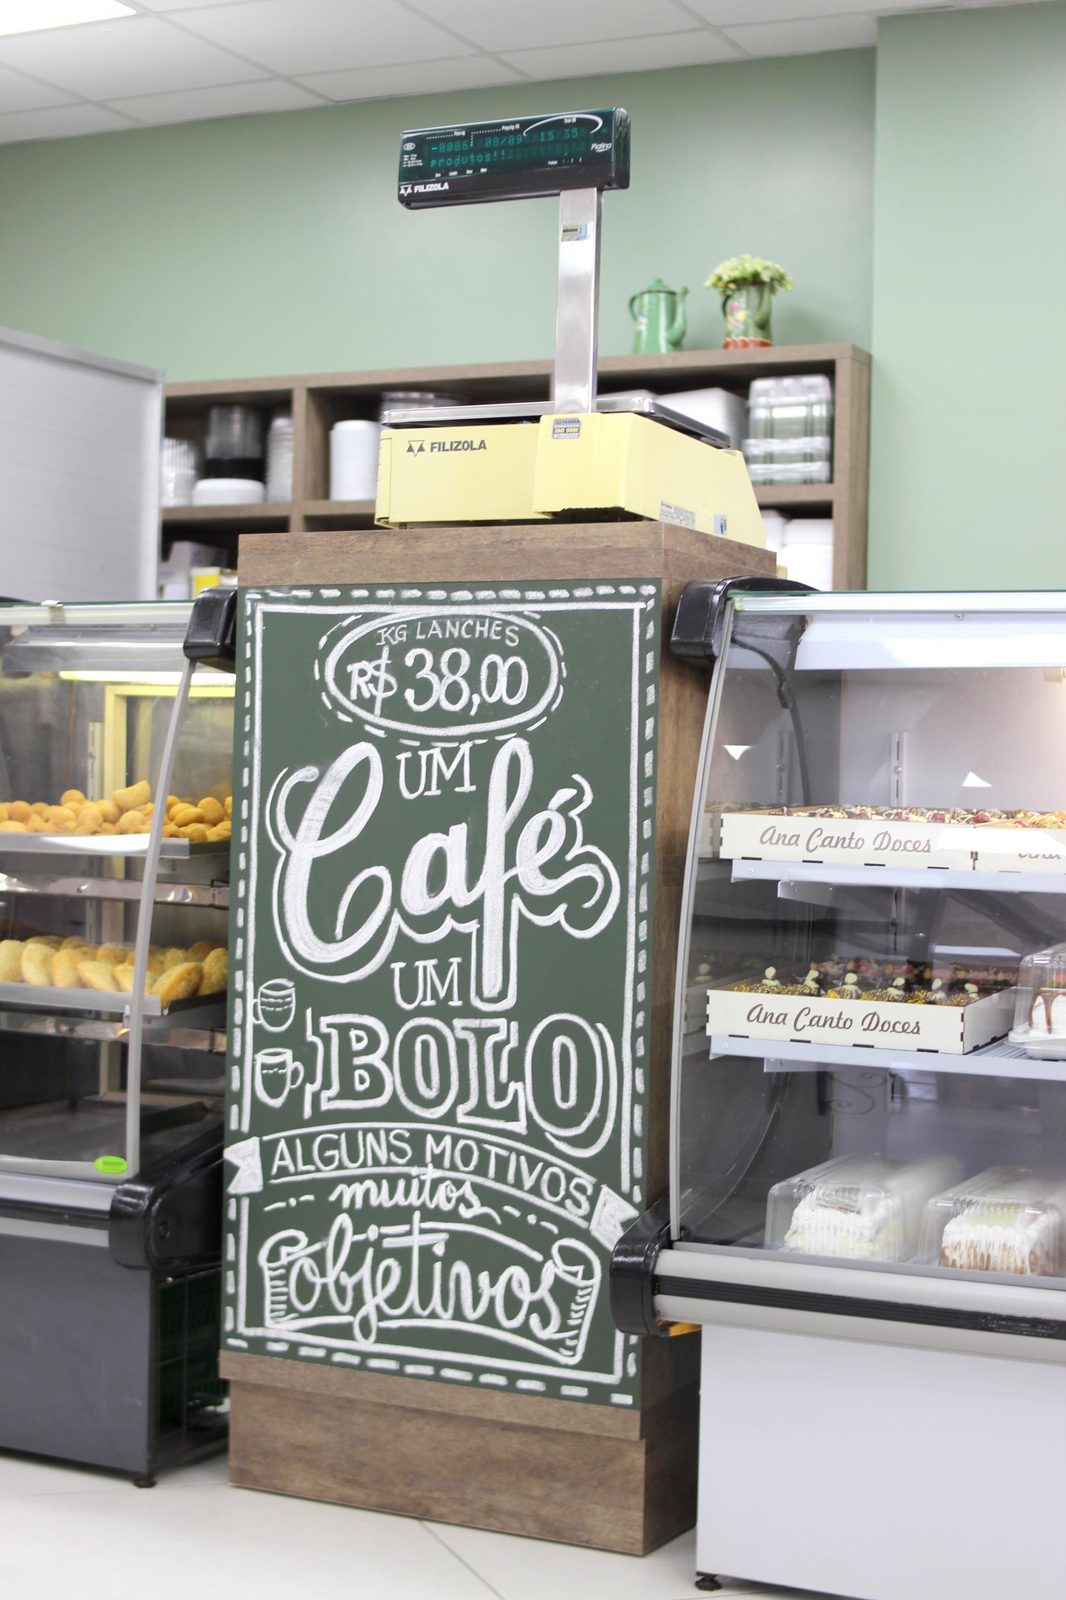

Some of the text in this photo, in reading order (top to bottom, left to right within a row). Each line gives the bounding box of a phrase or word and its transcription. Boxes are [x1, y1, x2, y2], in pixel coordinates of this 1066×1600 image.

[414, 182, 450, 194] FILIZOLA
[430, 439, 487, 453] FILIZOLA
[375, 619, 520, 648] KG LANCHES
[346, 646, 530, 717] R$ 38,00
[396, 741, 477, 800] UM
[276, 737, 606, 999] Café
[759, 825, 932, 854] Ana Canto Doces
[390, 957, 463, 1011] UM
[746, 1003, 921, 1035] Ana Canto Doces
[319, 1012, 605, 1138] BOLO
[270, 1128, 594, 1217] ALGUNS MOTIVOS
[328, 1162, 502, 1225] muitos
[288, 1210, 572, 1344] objetivos
